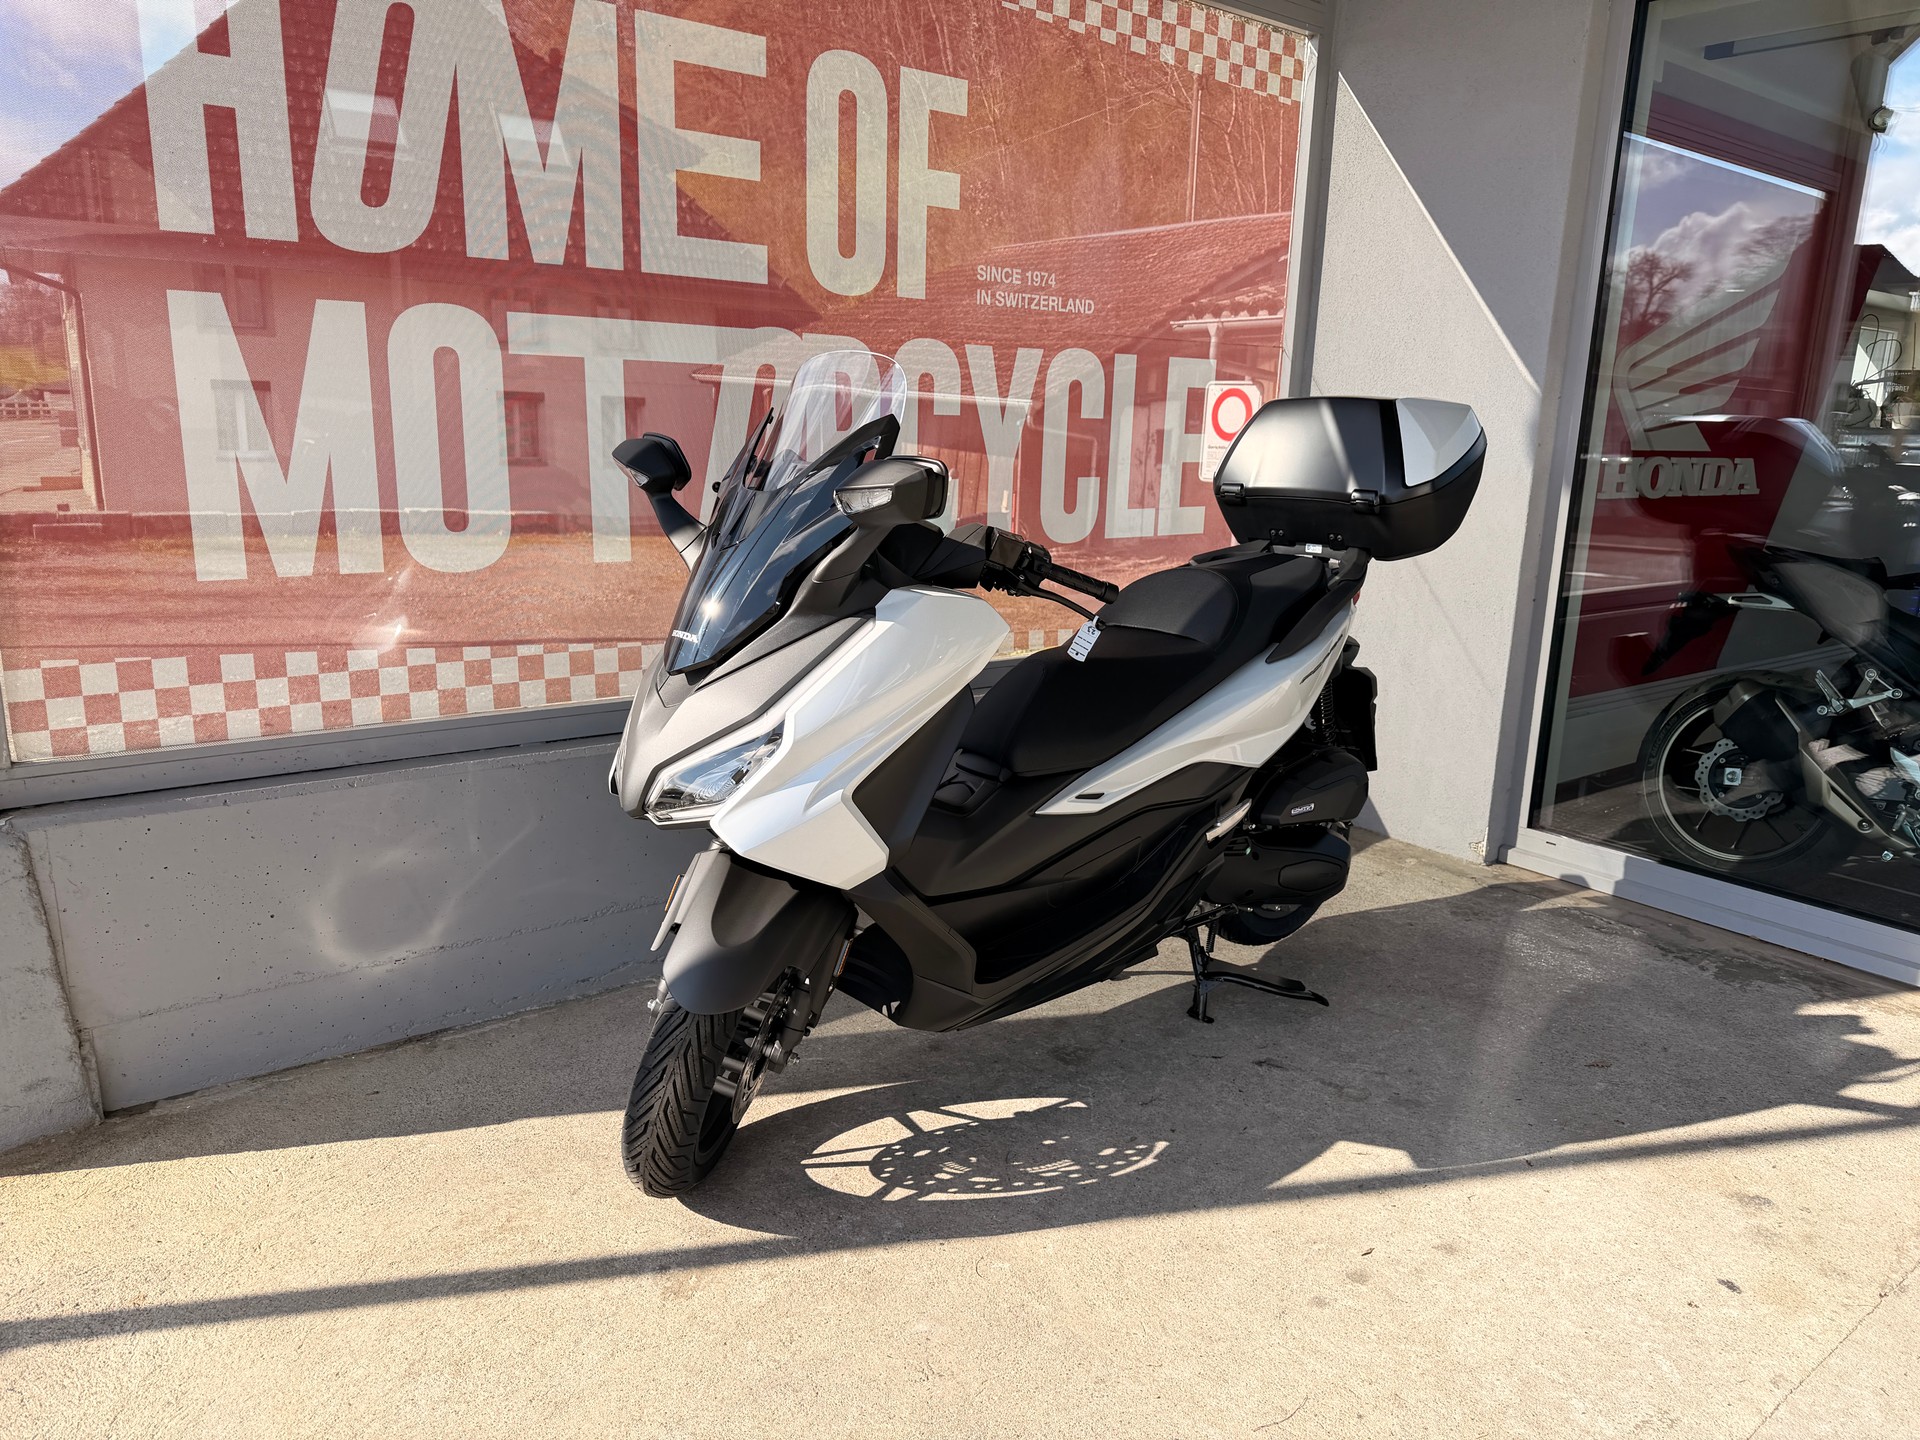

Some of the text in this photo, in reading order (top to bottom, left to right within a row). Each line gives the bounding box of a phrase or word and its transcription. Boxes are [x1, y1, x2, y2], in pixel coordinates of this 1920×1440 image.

[138, 0, 969, 301] HOME OF
[976, 264, 1056, 288] SINCE 1974
[976, 289, 1095, 315] IN SWITZERLAND
[1597, 456, 1760, 499] HONDA
